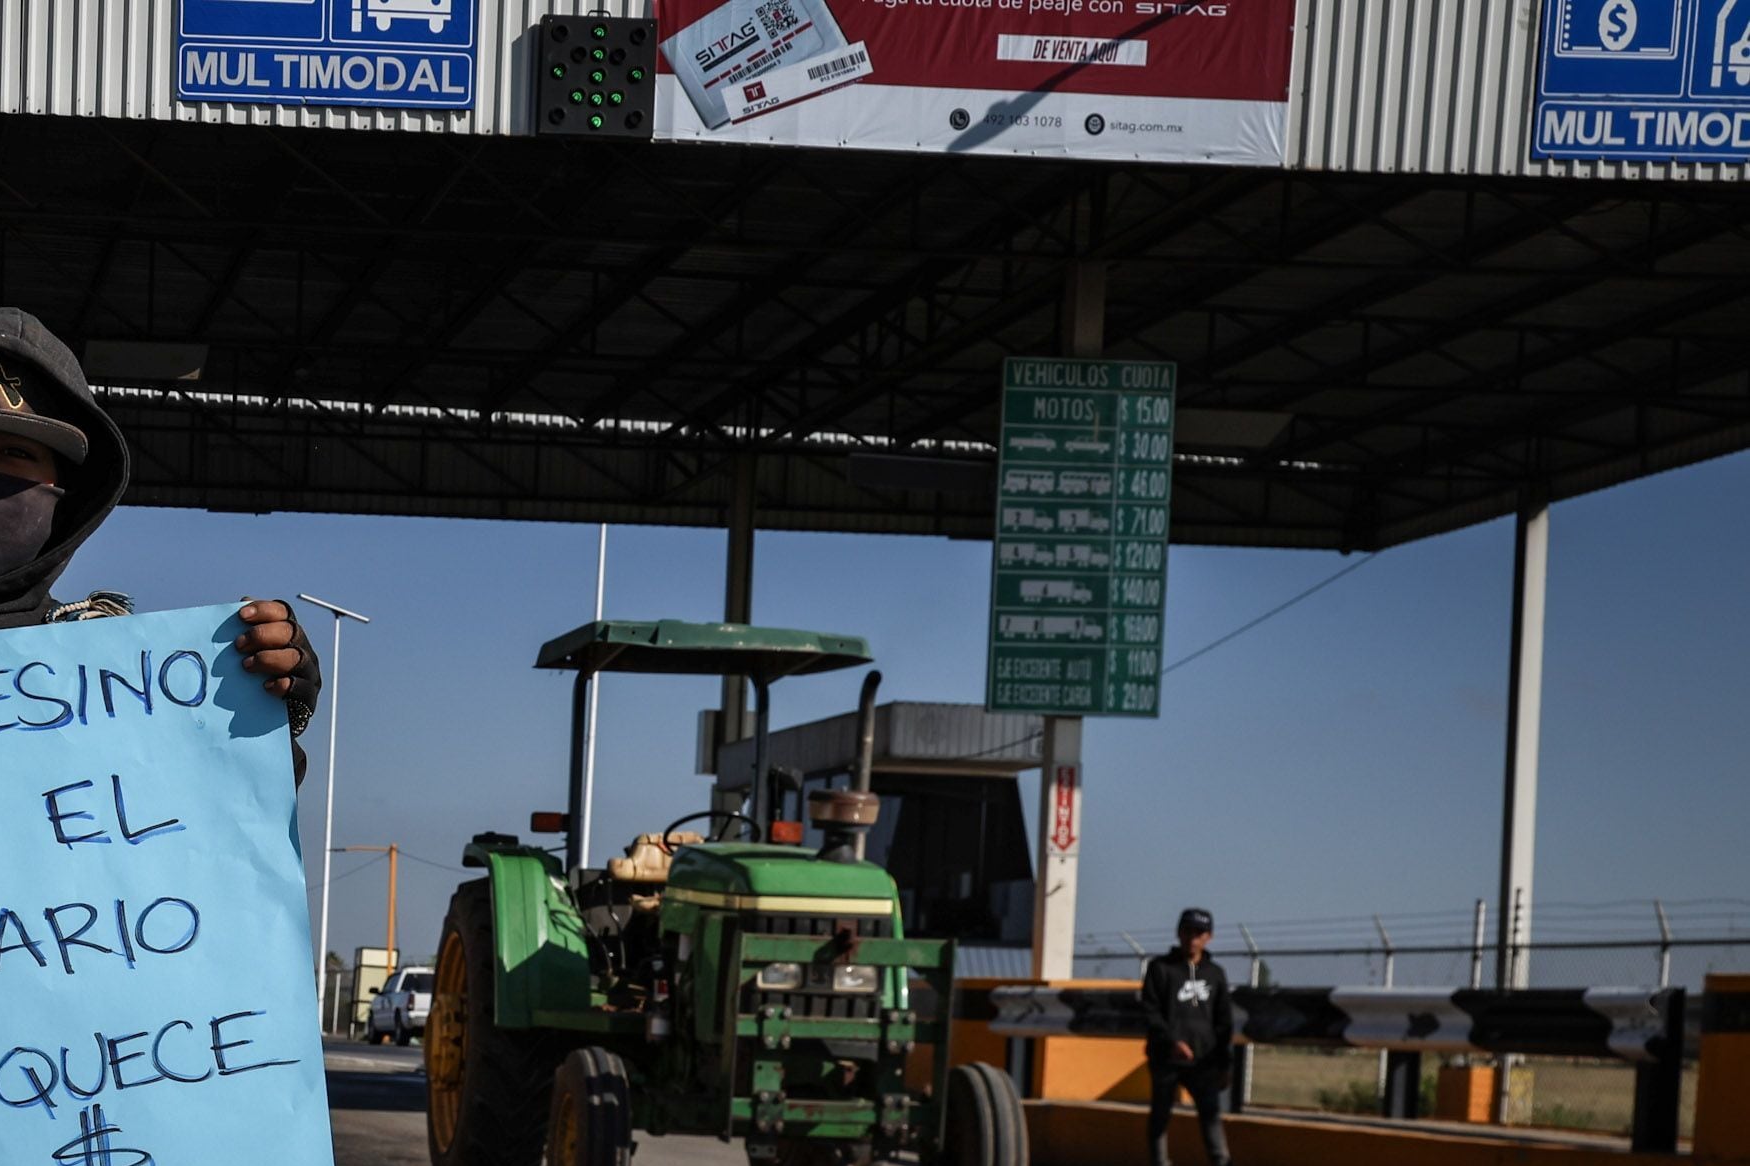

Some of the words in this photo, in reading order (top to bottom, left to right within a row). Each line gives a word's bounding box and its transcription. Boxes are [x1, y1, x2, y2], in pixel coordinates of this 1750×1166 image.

[1029, 0, 1083, 16] peaje
[1089, 1, 1123, 13] con
[1136, 2, 1227, 17] SITAG
[695, 21, 756, 65] SITAG
[1033, 39, 1050, 59] DE
[1051, 40, 1088, 60] VENTA
[186, 51, 465, 94] MULTIMODAL
[984, 114, 1005, 126] 492
[1008, 115, 1029, 126] 103
[1034, 115, 1062, 128] 1078
[1109, 120, 1183, 133] sitag.com.mx
[1013, 362, 1109, 386] VEHICULOS
[1121, 366, 1170, 388] CUOTA
[1034, 397, 1095, 421] MOTOS
[1135, 396, 1169, 425] 15.00
[1132, 431, 1168, 460] 30.00
[1130, 469, 1166, 497] 46.00
[1130, 507, 1165, 535] 71.00
[42, 774, 186, 850] EL
